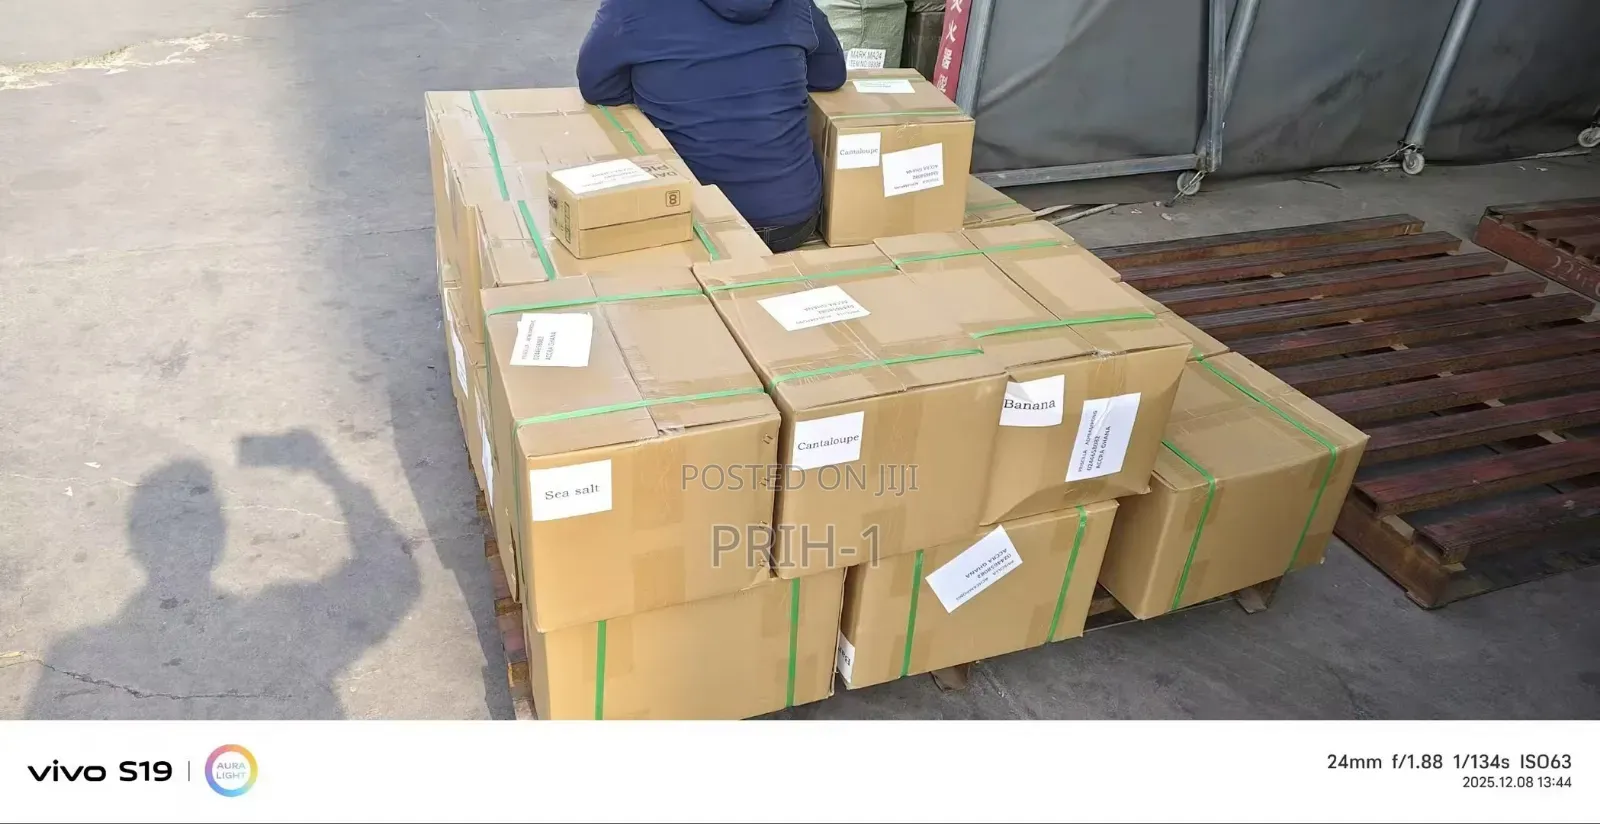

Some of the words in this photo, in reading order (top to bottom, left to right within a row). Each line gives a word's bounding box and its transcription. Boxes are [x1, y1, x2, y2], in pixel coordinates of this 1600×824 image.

[839, 147, 879, 156] Cantaloupe
[669, 194, 678, 205] 8
[1004, 399, 1056, 410] Banana
[797, 433, 860, 452] Cantaloupe
[544, 490, 569, 501] Sea
[575, 484, 601, 496] salt
[965, 562, 988, 579] GHANA
